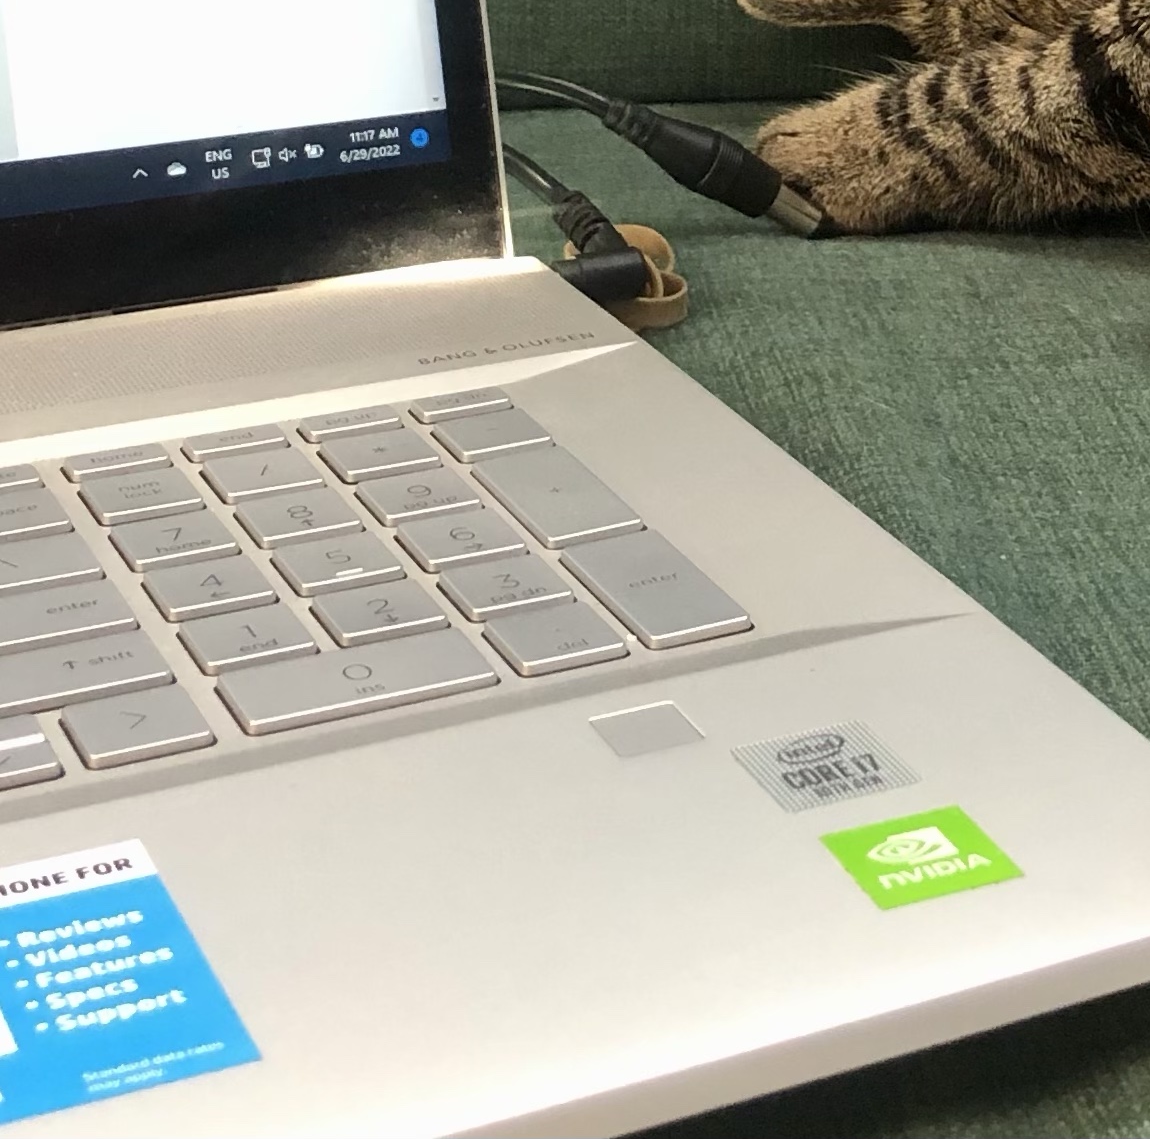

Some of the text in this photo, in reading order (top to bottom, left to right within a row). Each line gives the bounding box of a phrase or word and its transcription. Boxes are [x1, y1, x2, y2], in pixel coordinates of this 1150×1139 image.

[378, 126, 399, 140] AM
[205, 148, 233, 163] ENG
[340, 144, 401, 163] 6/29/2022
[211, 166, 230, 180] US
[418, 349, 477, 365] BANG
[502, 331, 595, 352] OLUFSEN
[118, 480, 161, 493] num
[406, 484, 432, 498] 9
[287, 505, 314, 519] 8
[161, 527, 183, 542] 7
[449, 526, 475, 541] 6
[155, 538, 212, 554] home
[325, 548, 351, 564] 5
[492, 573, 520, 589] 3
[629, 572, 678, 588] enter
[46, 599, 98, 614] enter
[366, 598, 390, 615] 2
[240, 625, 257, 638] 1
[239, 638, 278, 653] end
[88, 649, 135, 666] shift
[356, 682, 386, 695] ins
[782, 760, 855, 790] CORE
[75, 858, 133, 879] FOR
[877, 852, 992, 890] NVIDIA
[16, 910, 144, 948] Reviews
[25, 935, 131, 967] Videos
[35, 947, 173, 988] Features
[46, 978, 138, 1010] Specs
[55, 989, 188, 1032] Support
[153, 1050, 185, 1065] data
